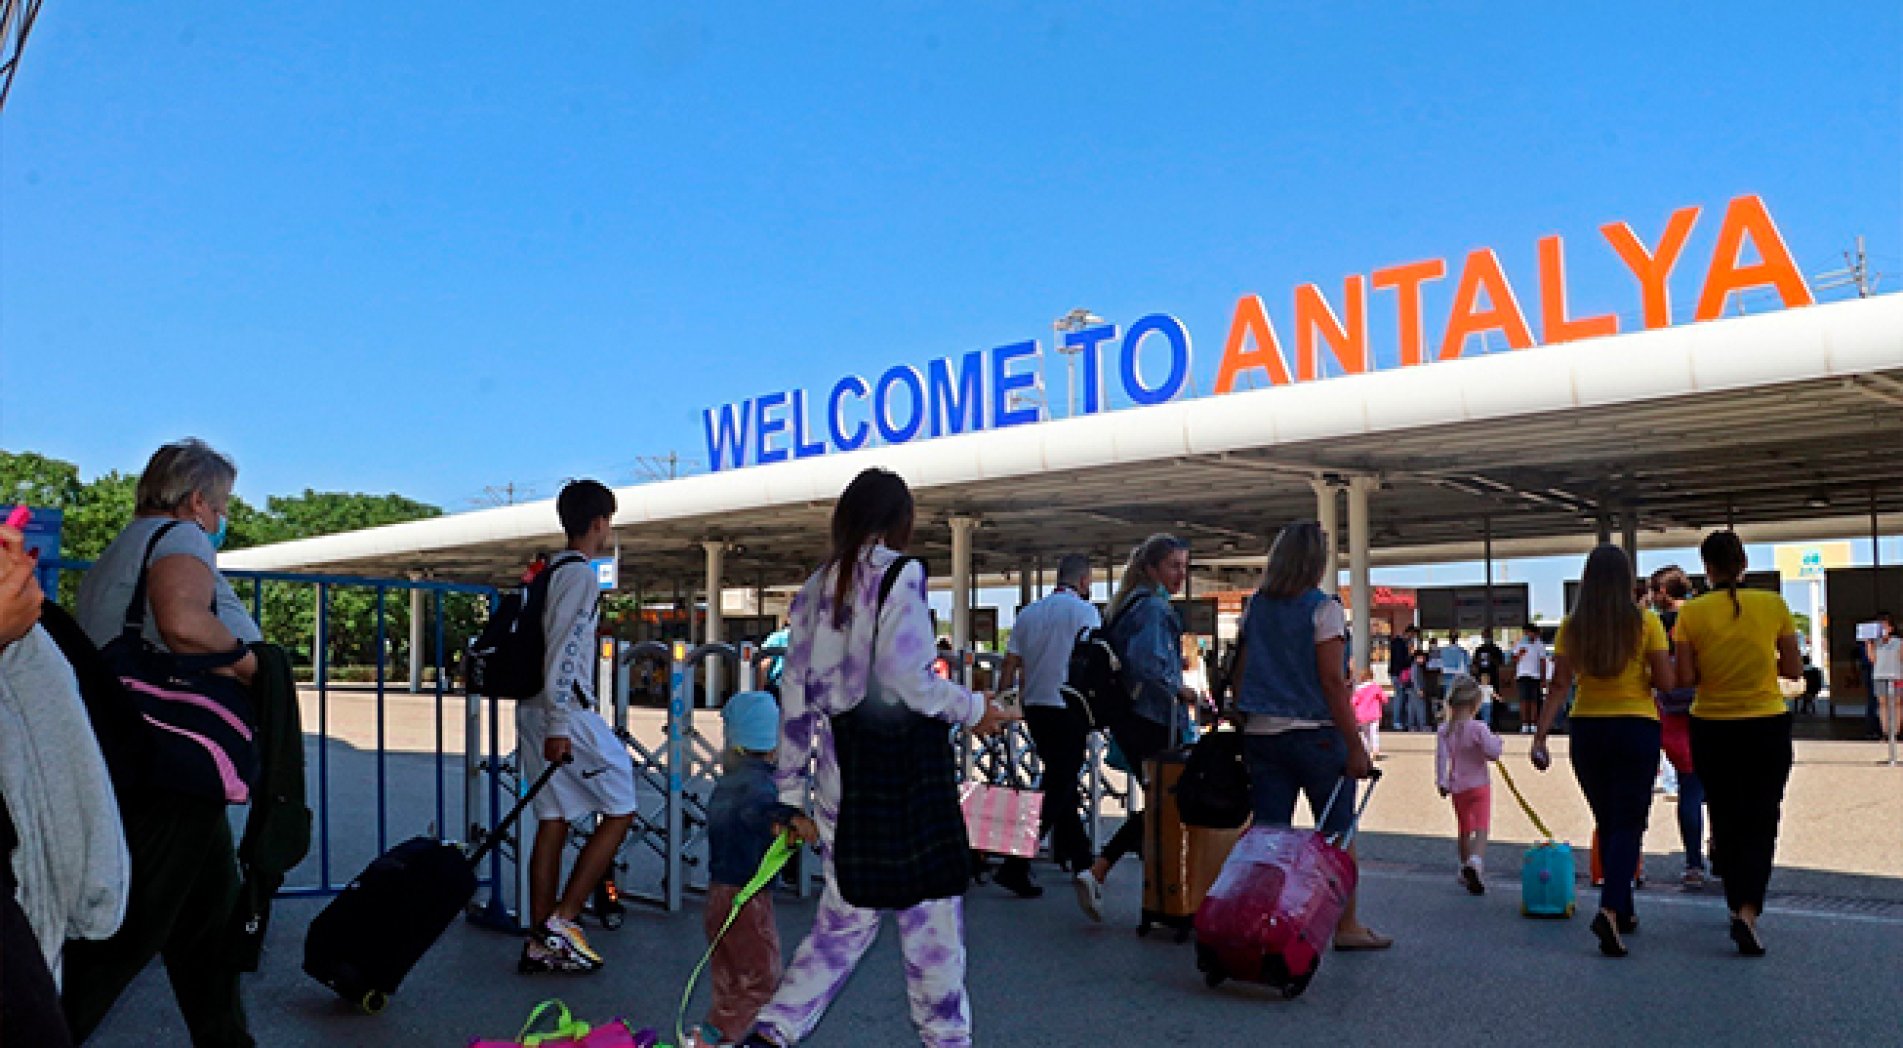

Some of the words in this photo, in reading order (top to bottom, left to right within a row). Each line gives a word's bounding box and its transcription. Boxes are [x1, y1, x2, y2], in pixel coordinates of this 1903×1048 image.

[702, 338, 1044, 472] WELCOME
[1064, 312, 1193, 415] TO
[1213, 194, 1815, 395] ANTALYA
